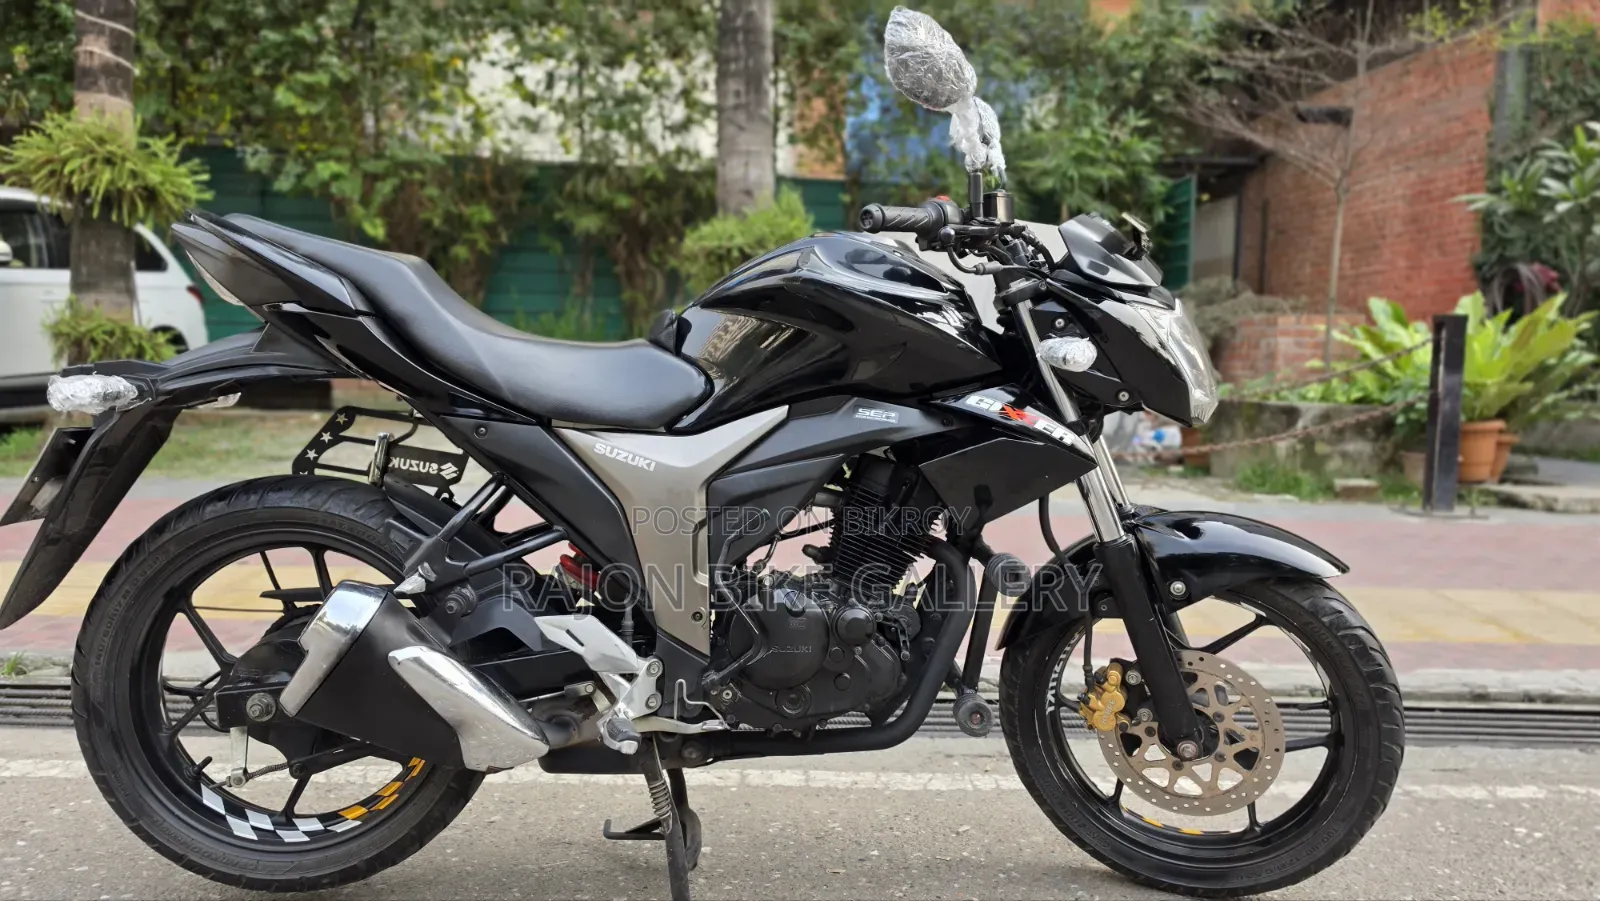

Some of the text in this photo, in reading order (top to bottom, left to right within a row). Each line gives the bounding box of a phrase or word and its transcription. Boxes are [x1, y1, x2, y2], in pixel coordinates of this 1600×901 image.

[856, 407, 896, 419] SEP
[593, 442, 656, 472] SUZUKI
[771, 645, 812, 653] SUZUKI
